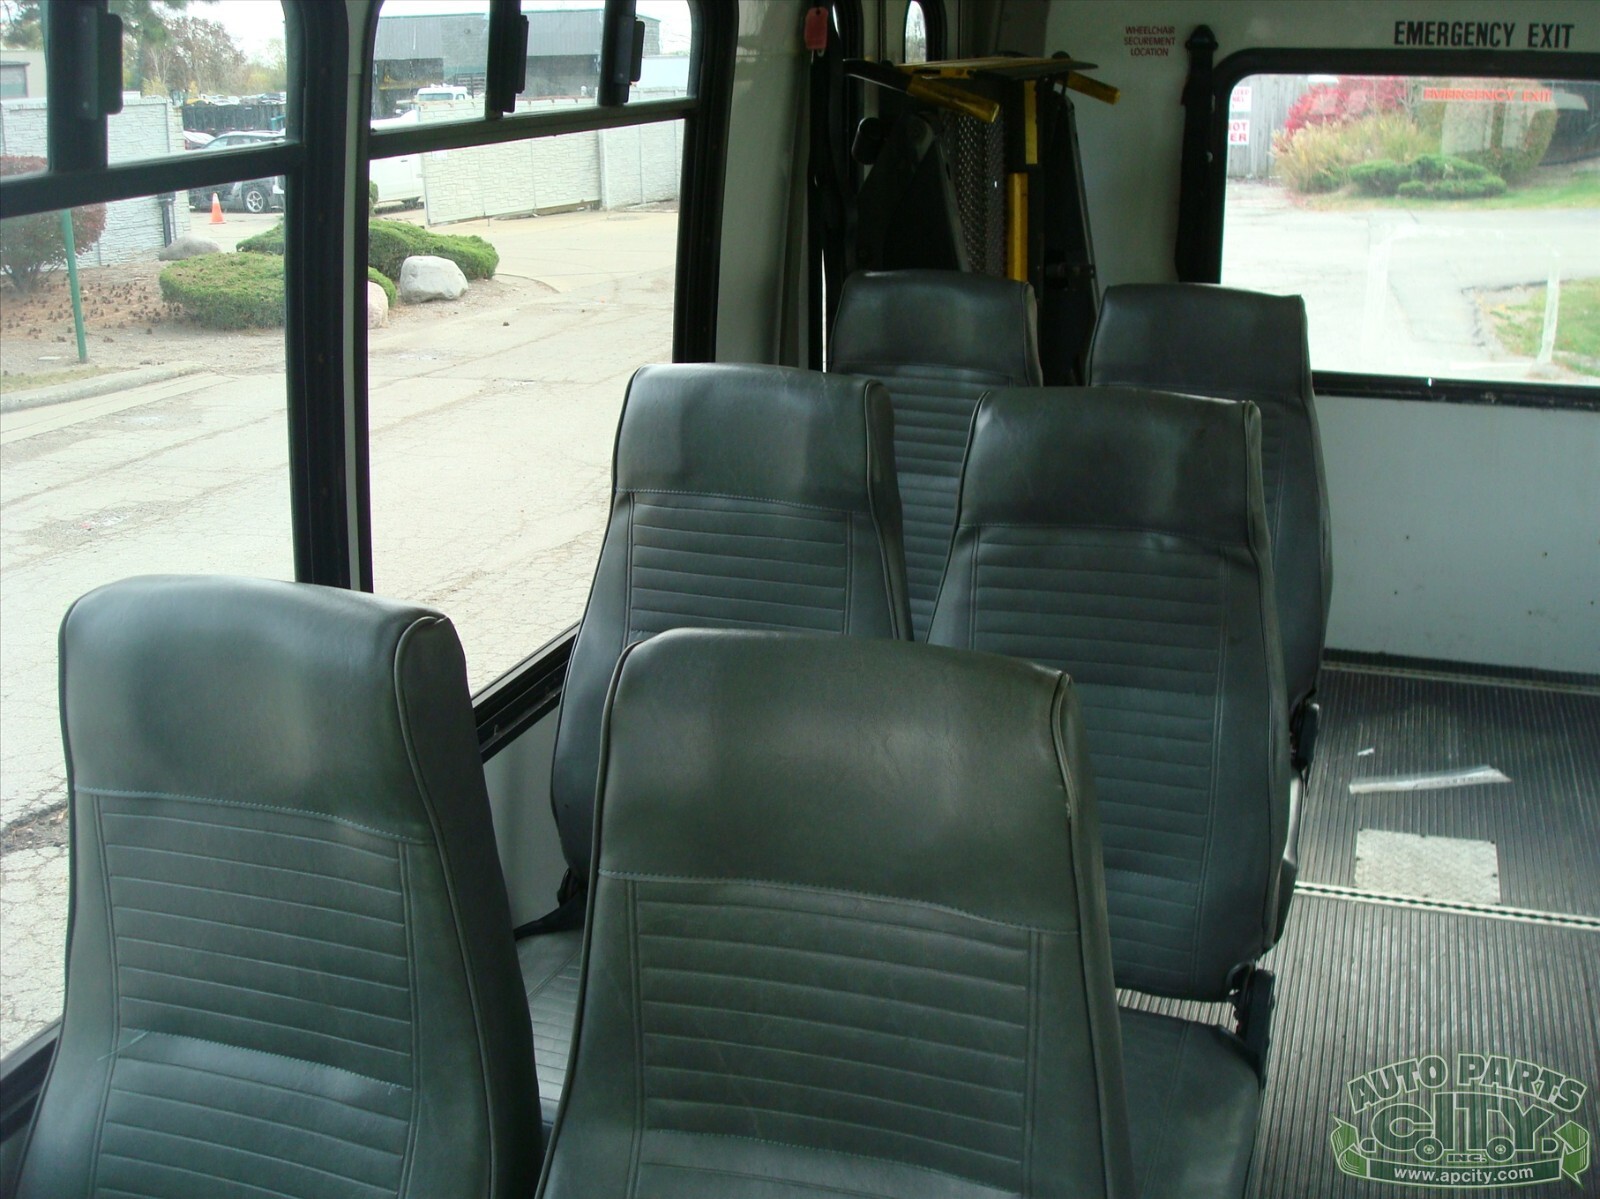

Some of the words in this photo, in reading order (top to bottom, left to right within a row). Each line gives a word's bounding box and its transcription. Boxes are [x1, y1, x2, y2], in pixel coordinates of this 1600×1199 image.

[1125, 26, 1175, 35] WHEELCHAIR
[1394, 20, 1516, 47] EMERGENCY
[1527, 22, 1575, 49] EXIT
[1123, 36, 1176, 46] SECUREMENT
[1130, 47, 1169, 57] LOCATION
[1423, 87, 1516, 102] EMERGENCY
[1521, 89, 1553, 103] EXIT
